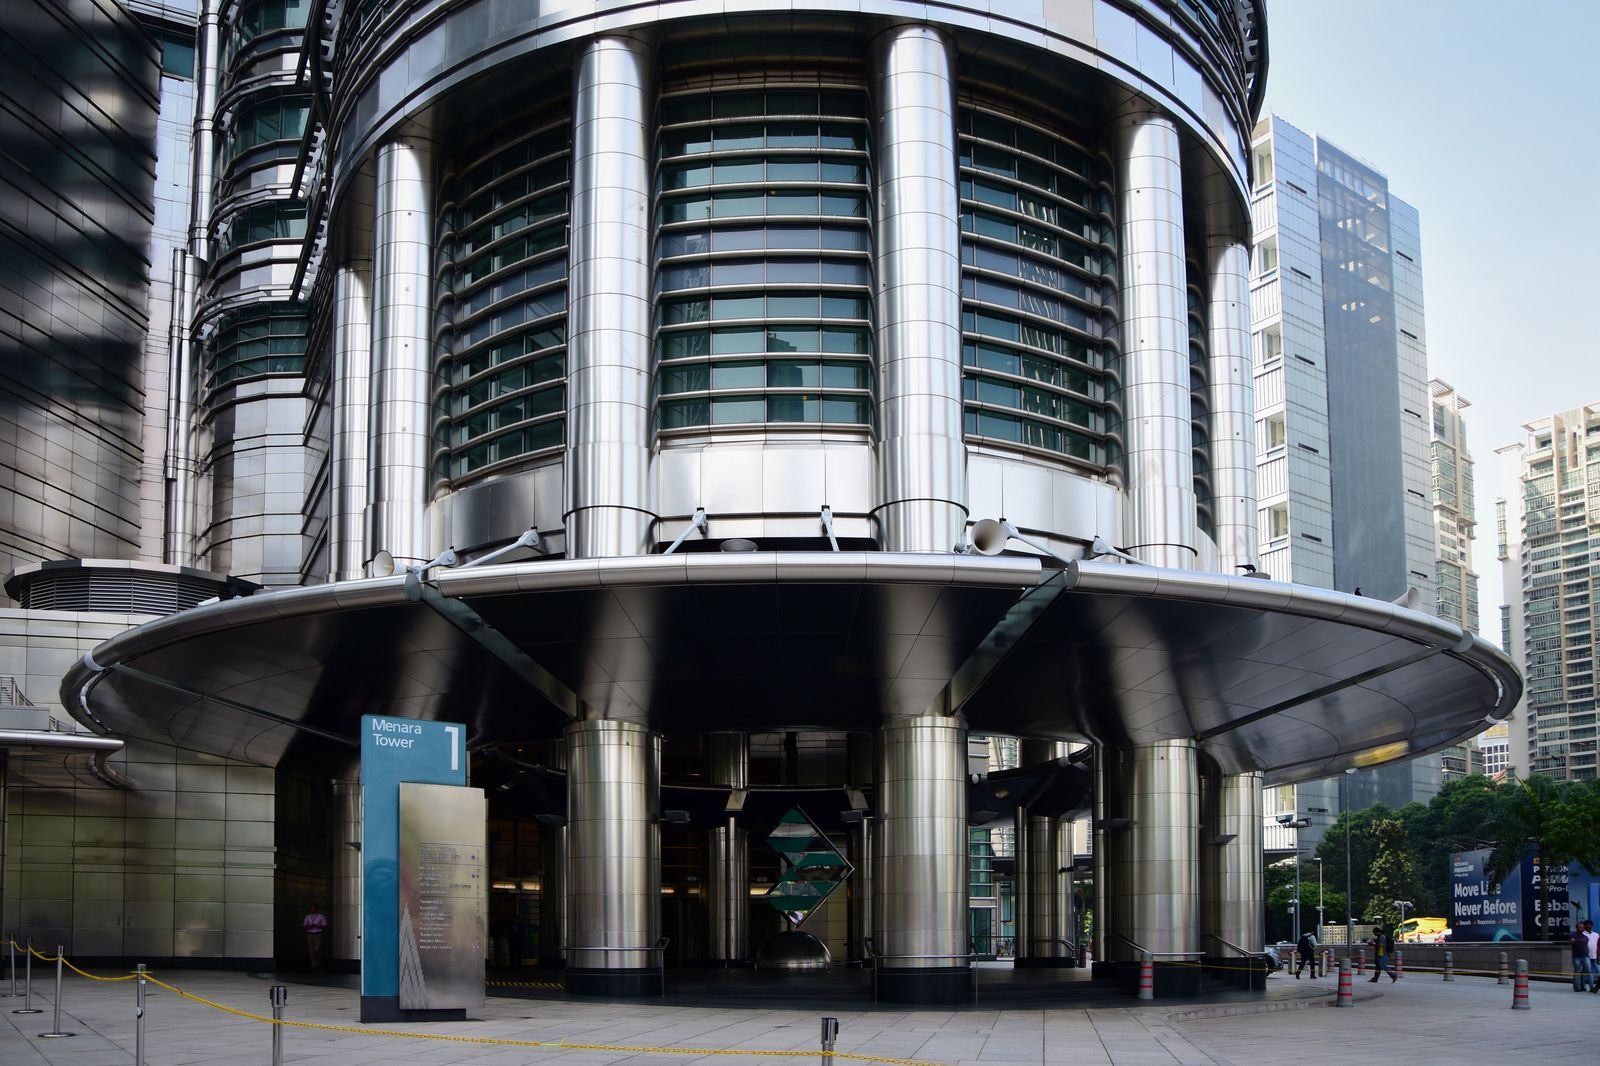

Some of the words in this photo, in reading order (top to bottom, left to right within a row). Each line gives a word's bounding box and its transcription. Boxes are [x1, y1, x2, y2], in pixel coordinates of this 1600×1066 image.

[372, 719, 422, 735] Menara
[373, 734, 415, 748] Tower
[444, 726, 459, 771] 1
[1454, 883, 1479, 898] Move
[1480, 880, 1501, 896] Lie
[1454, 901, 1481, 916] Never
[1483, 899, 1517, 915] Before
